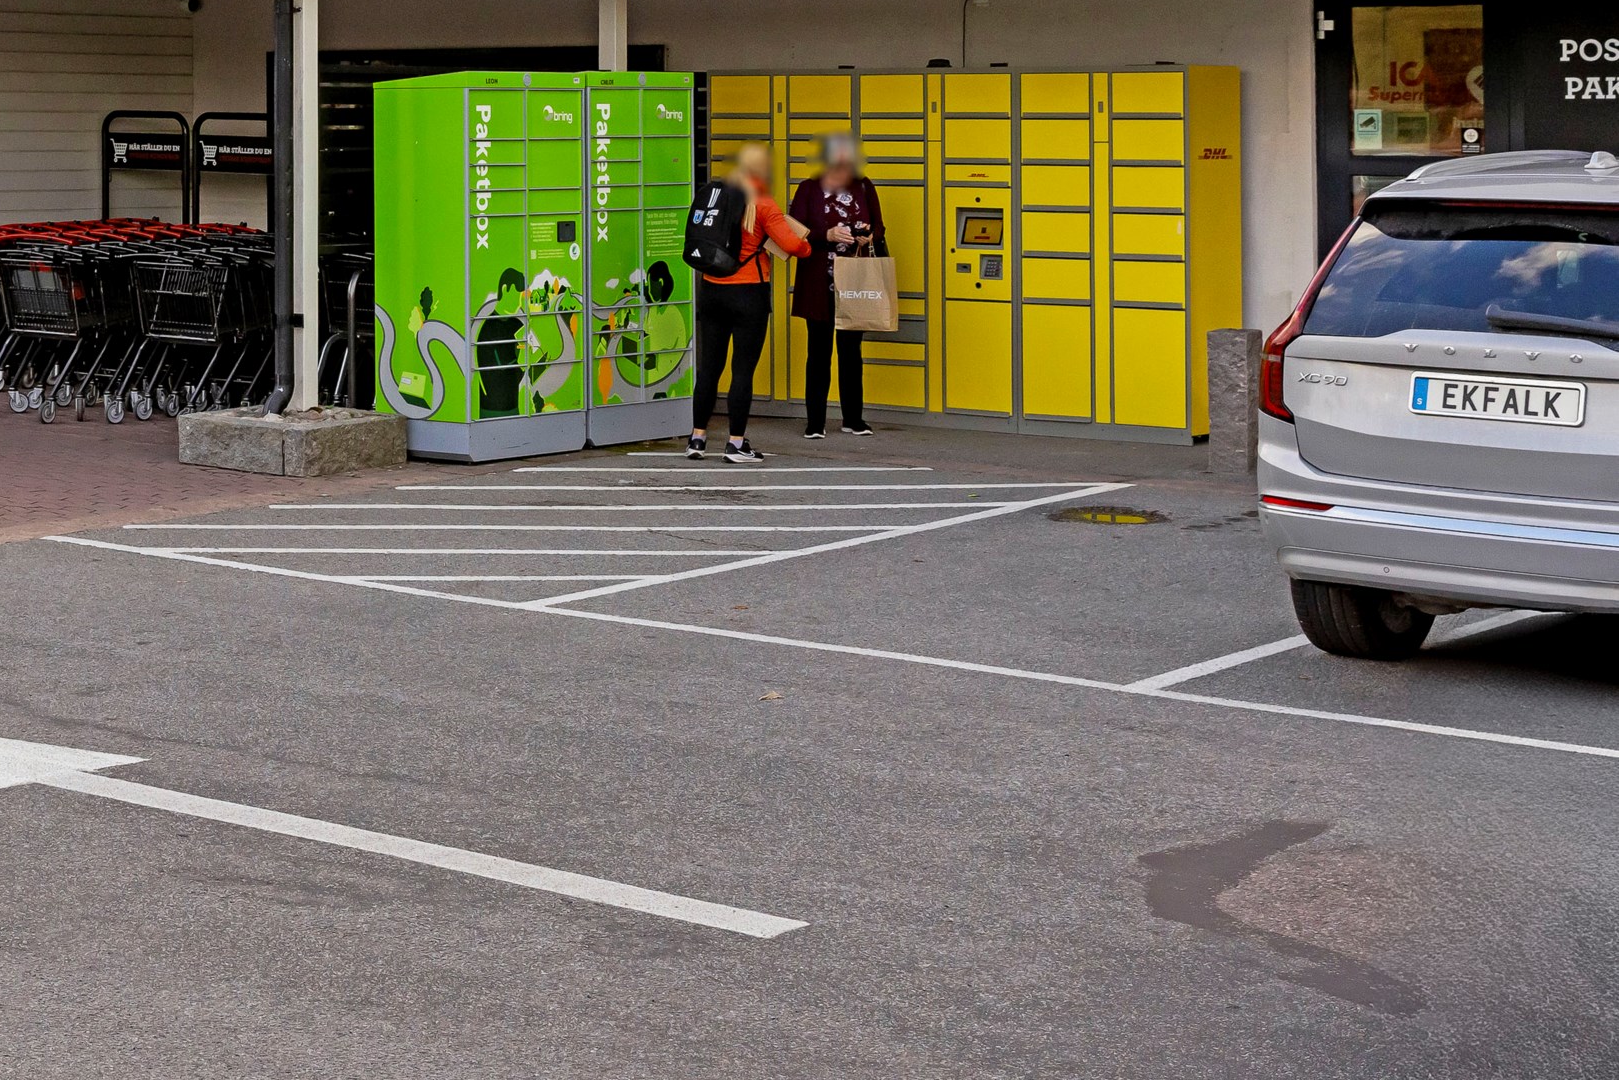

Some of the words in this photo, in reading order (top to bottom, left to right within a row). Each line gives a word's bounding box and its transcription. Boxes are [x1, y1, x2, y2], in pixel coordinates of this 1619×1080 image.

[553, 111, 573, 124] bring
[665, 110, 683, 122] bring
[128, 142, 141, 151] HÄR
[141, 142, 163, 151] STÄLLER
[163, 144, 172, 152] DU
[172, 144, 181, 152] EN
[218, 145, 231, 154] HÄR
[231, 145, 255, 155] STÄLLER
[254, 147, 264, 155] DU
[263, 148, 273, 156] EN
[1201, 147, 1229, 160] DHL
[475, 104, 492, 250] Paketbox
[596, 103, 611, 243] Paketbox
[838, 290, 883, 300] HEMTEX
[1404, 342, 1584, 363] VOLVO
[1416, 397, 1423, 406] S
[1441, 382, 1562, 419] EKFALK
